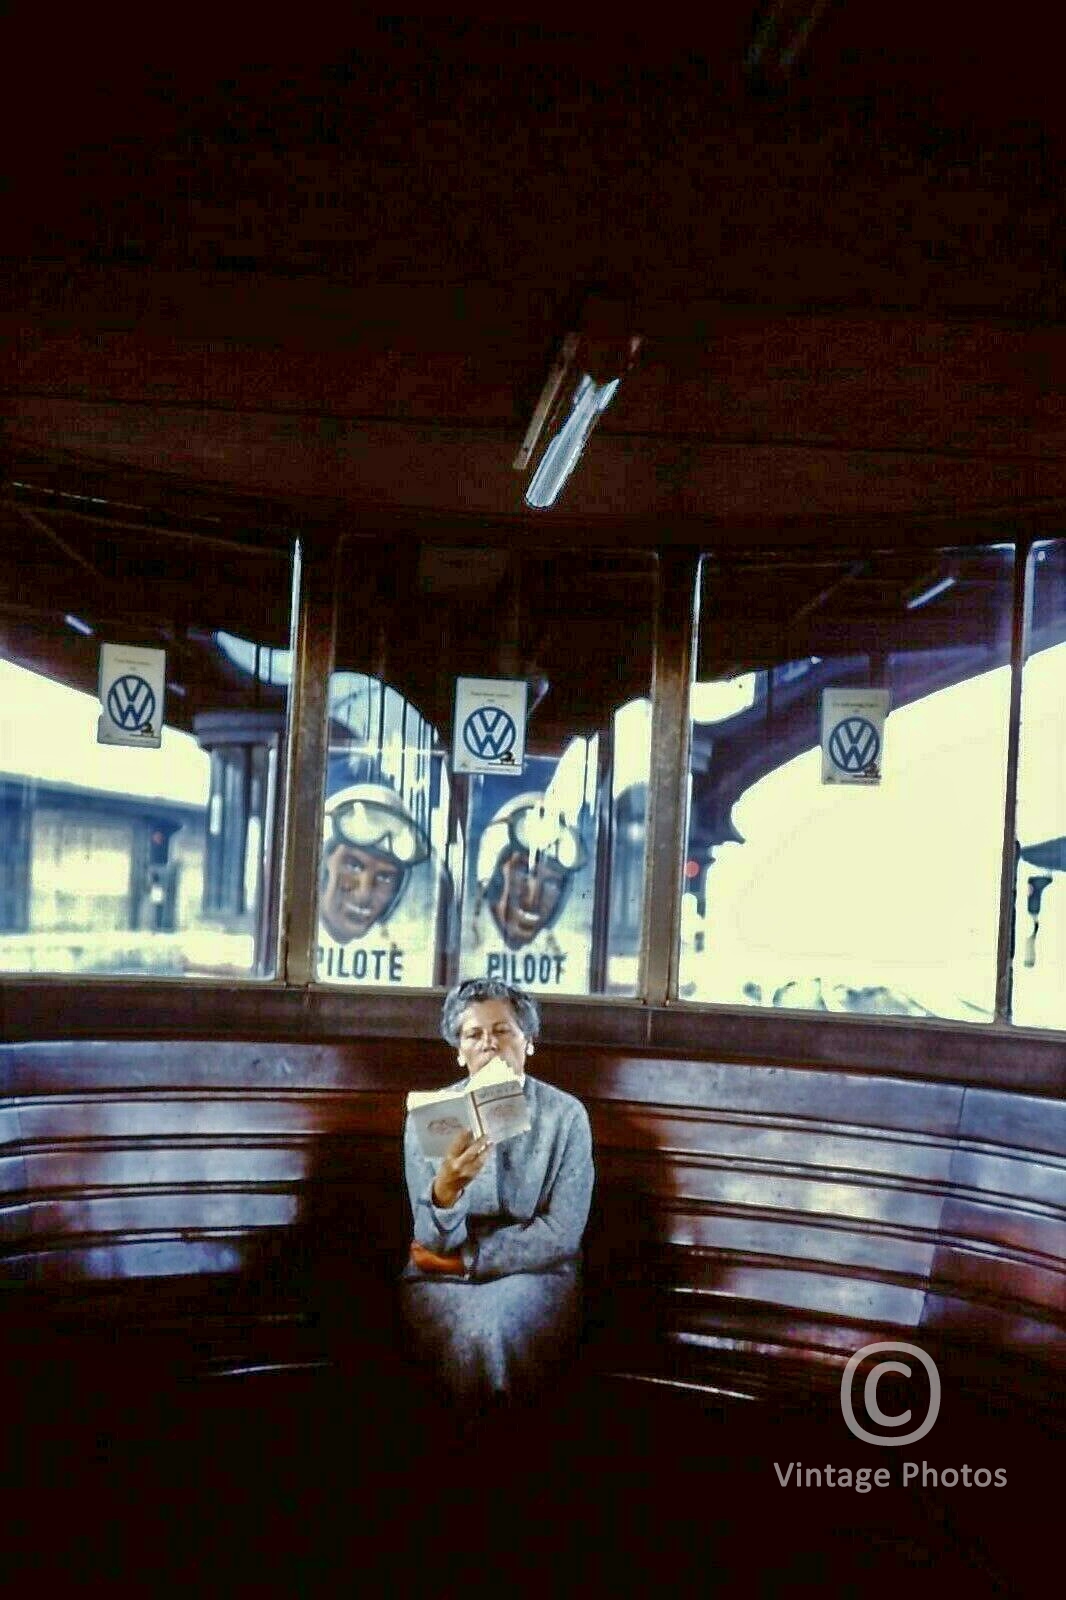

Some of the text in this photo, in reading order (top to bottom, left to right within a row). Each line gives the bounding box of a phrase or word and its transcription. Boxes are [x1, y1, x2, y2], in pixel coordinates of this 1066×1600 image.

[108, 675, 155, 731] VW
[464, 707, 516, 760] VW
[829, 717, 880, 773] VW
[487, 953, 568, 984] PILOOT
